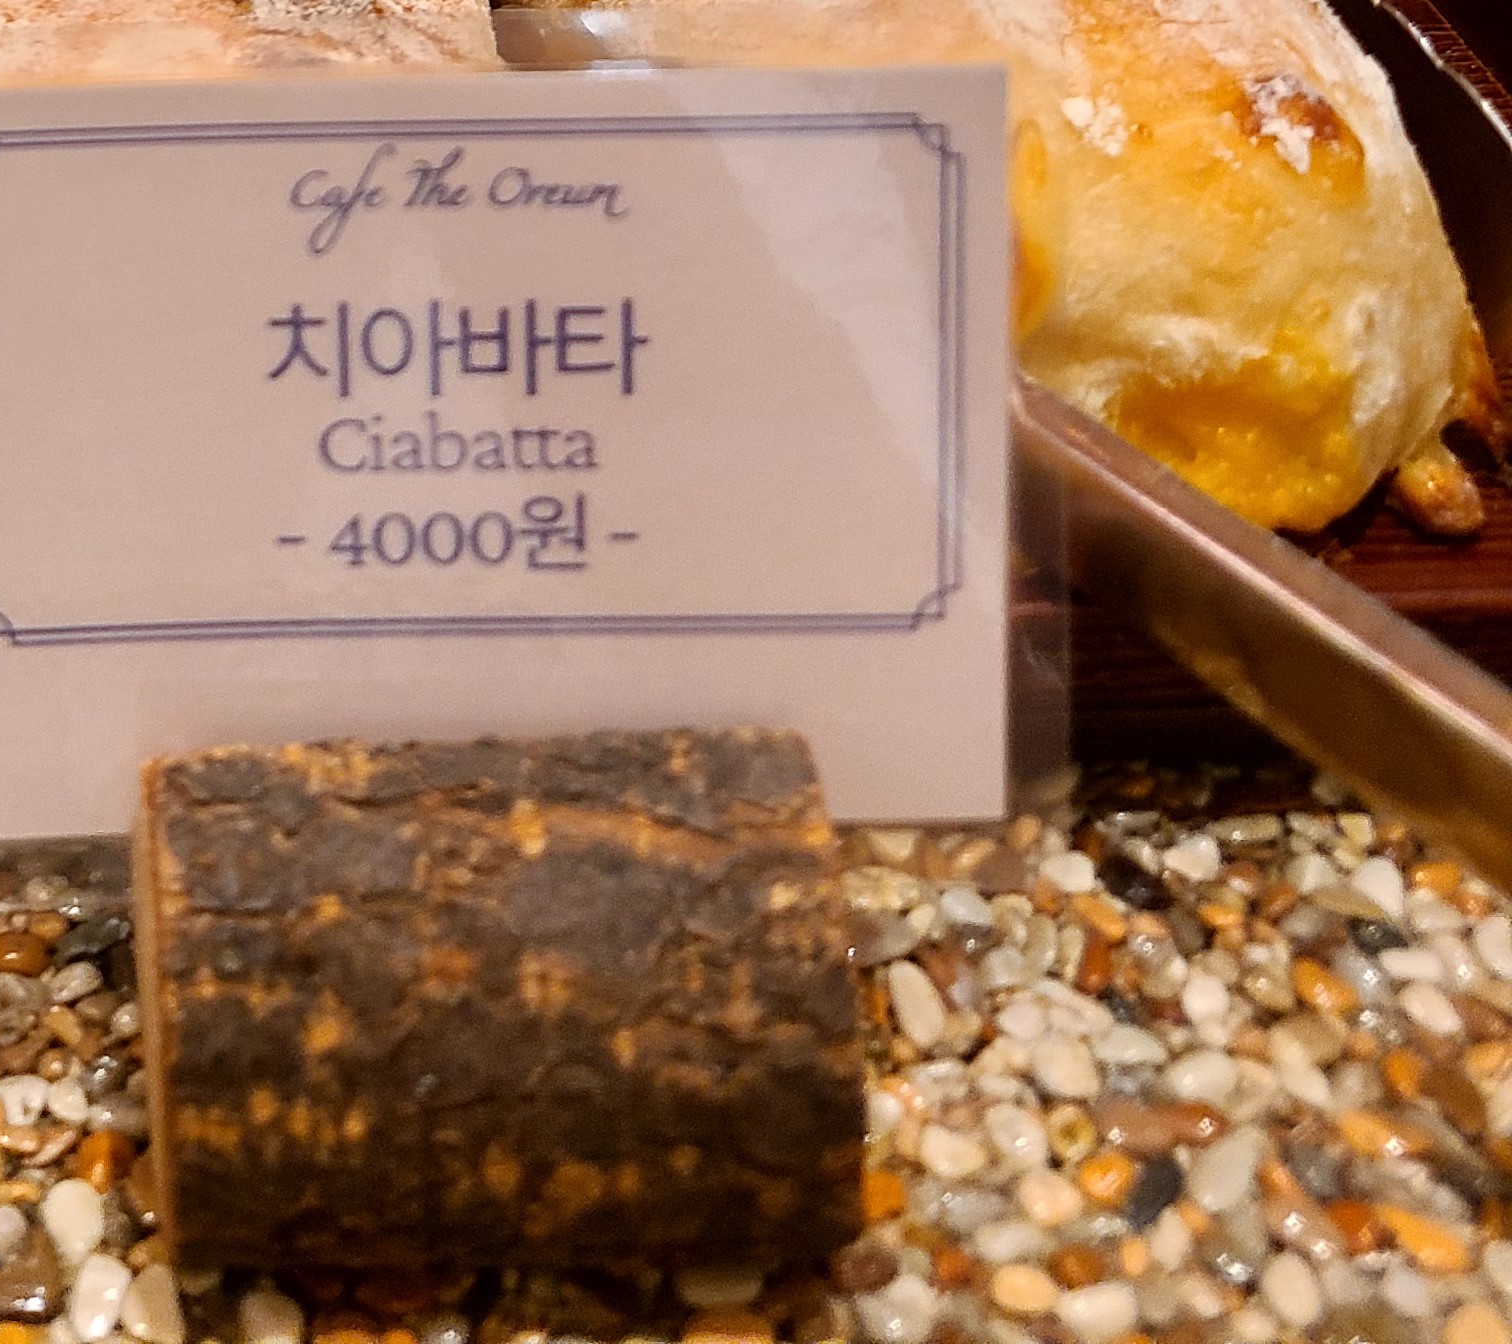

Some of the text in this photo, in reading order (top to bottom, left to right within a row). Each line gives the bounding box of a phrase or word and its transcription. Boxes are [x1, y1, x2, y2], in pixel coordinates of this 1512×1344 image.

[289, 142, 397, 255] Cafe
[404, 146, 472, 207] The
[266, 297, 650, 398] 치아바타
[318, 410, 600, 472] Ciabatta
